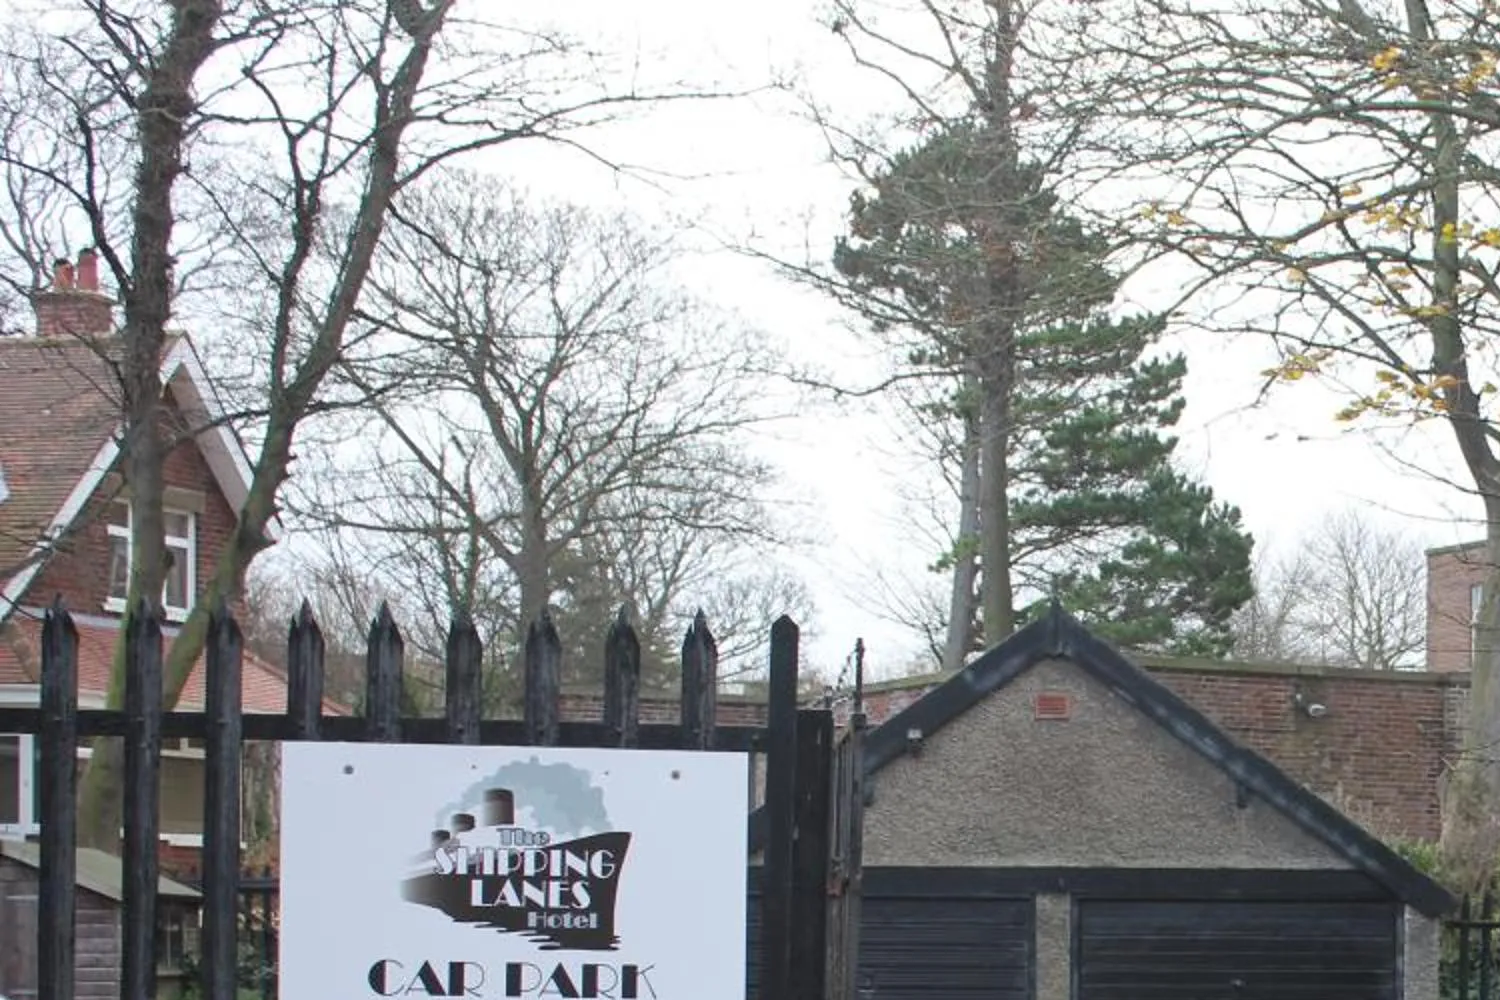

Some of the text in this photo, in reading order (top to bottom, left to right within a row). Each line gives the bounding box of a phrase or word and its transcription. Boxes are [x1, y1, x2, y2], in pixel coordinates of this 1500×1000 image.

[497, 827, 551, 847] The
[434, 848, 615, 880] SHIPPING
[470, 879, 591, 909] LANES
[527, 911, 599, 930] Hotel
[367, 959, 658, 1000] CAR PARK
